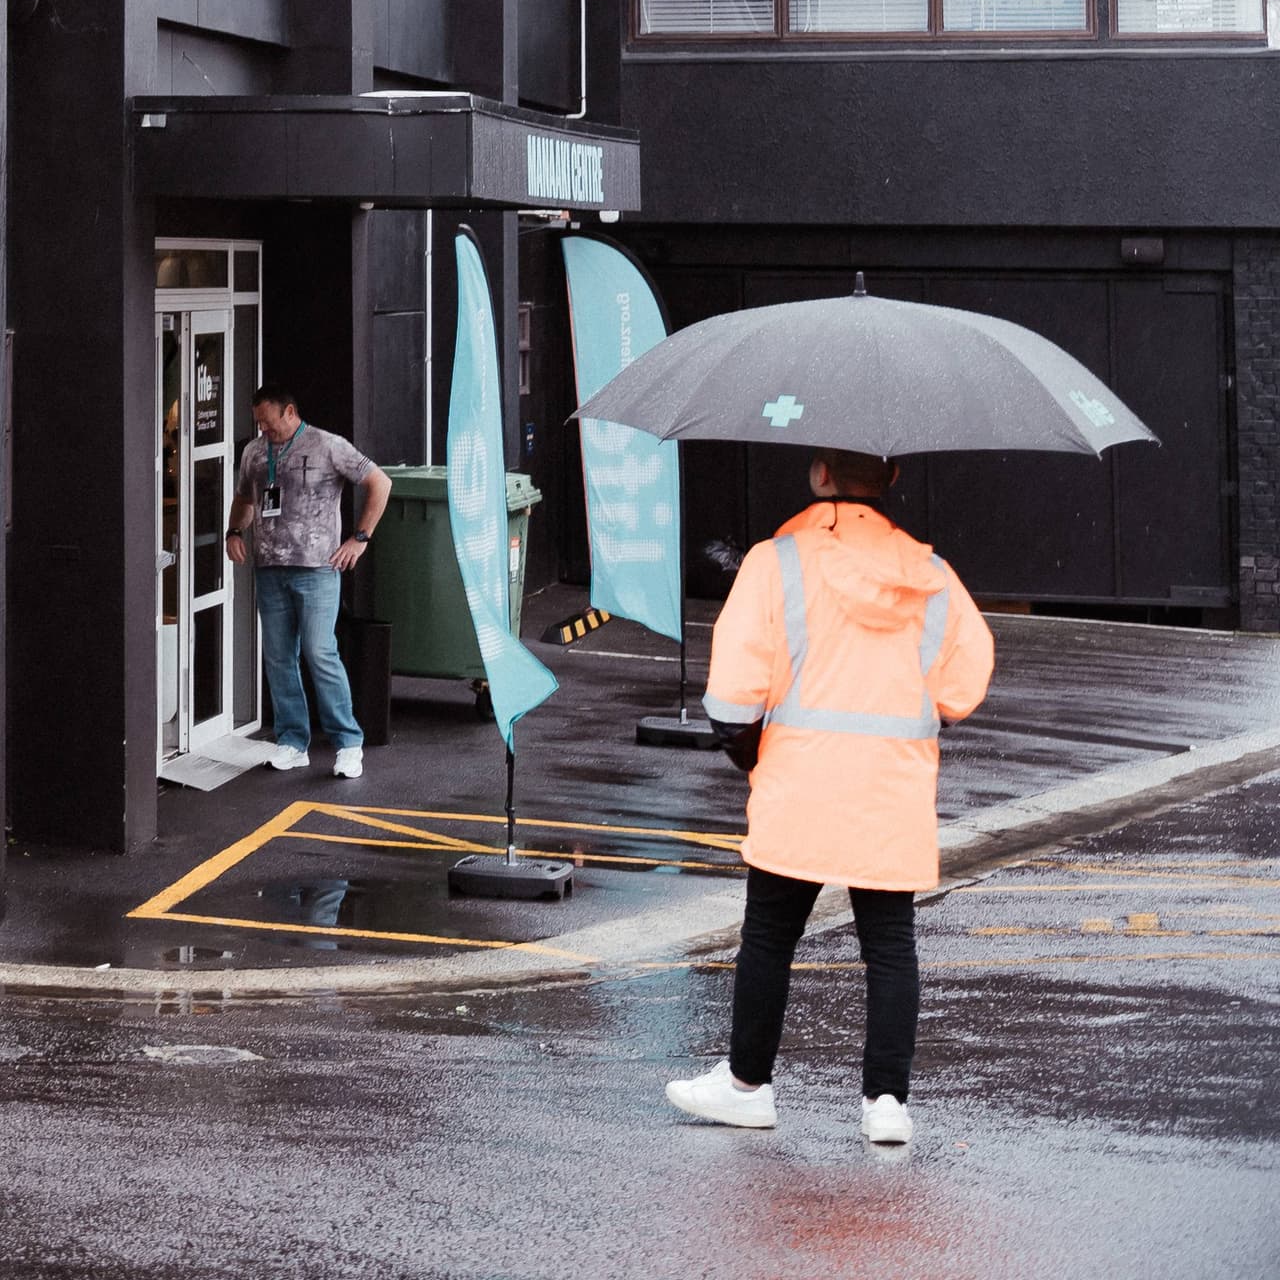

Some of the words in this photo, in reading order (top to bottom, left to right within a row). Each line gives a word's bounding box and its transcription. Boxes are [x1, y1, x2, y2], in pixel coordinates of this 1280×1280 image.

[527, 134, 571, 200] MANAAKI
[571, 142, 604, 202] CENTRE
[197, 363, 213, 403] life
